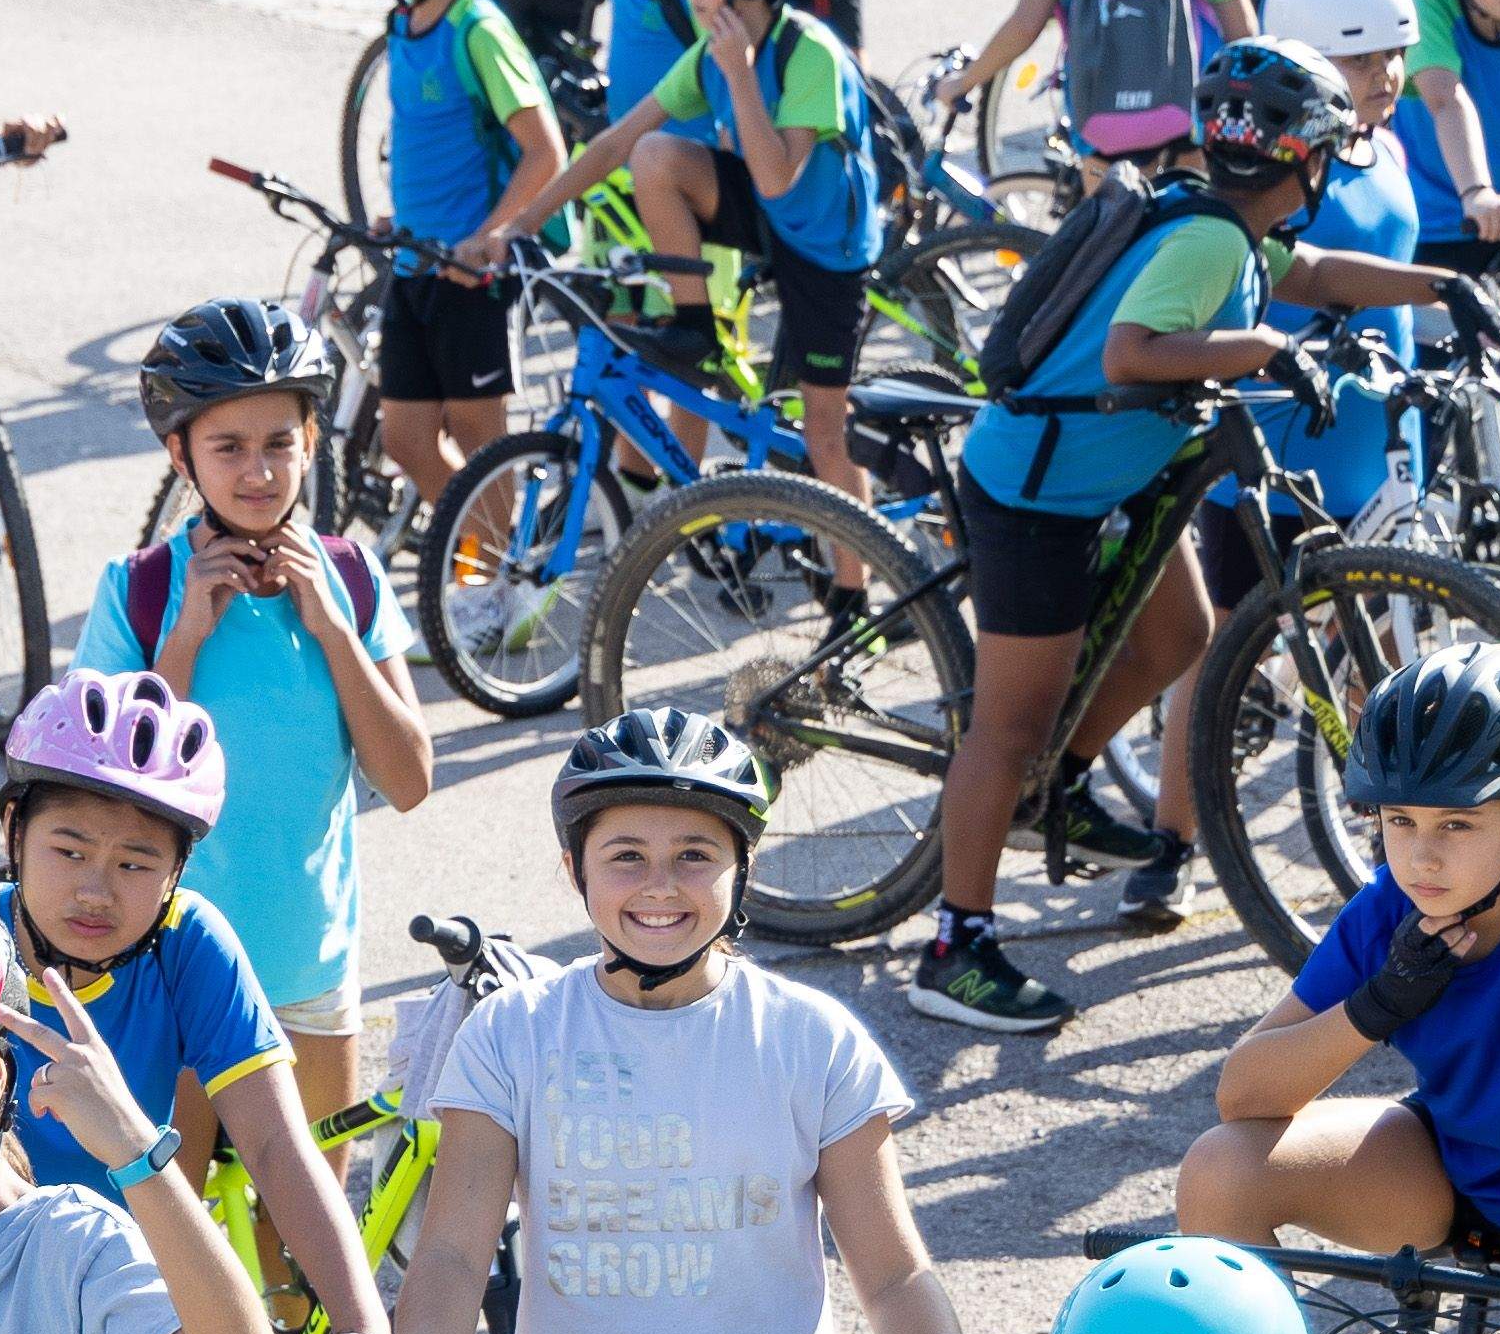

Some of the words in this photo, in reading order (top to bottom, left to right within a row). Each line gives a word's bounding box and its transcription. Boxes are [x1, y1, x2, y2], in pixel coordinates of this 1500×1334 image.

[545, 1049, 641, 1105] LET
[546, 1112, 693, 1170] YOUR
[547, 1173, 781, 1233] DREAMS
[547, 1241, 716, 1298] GROW
